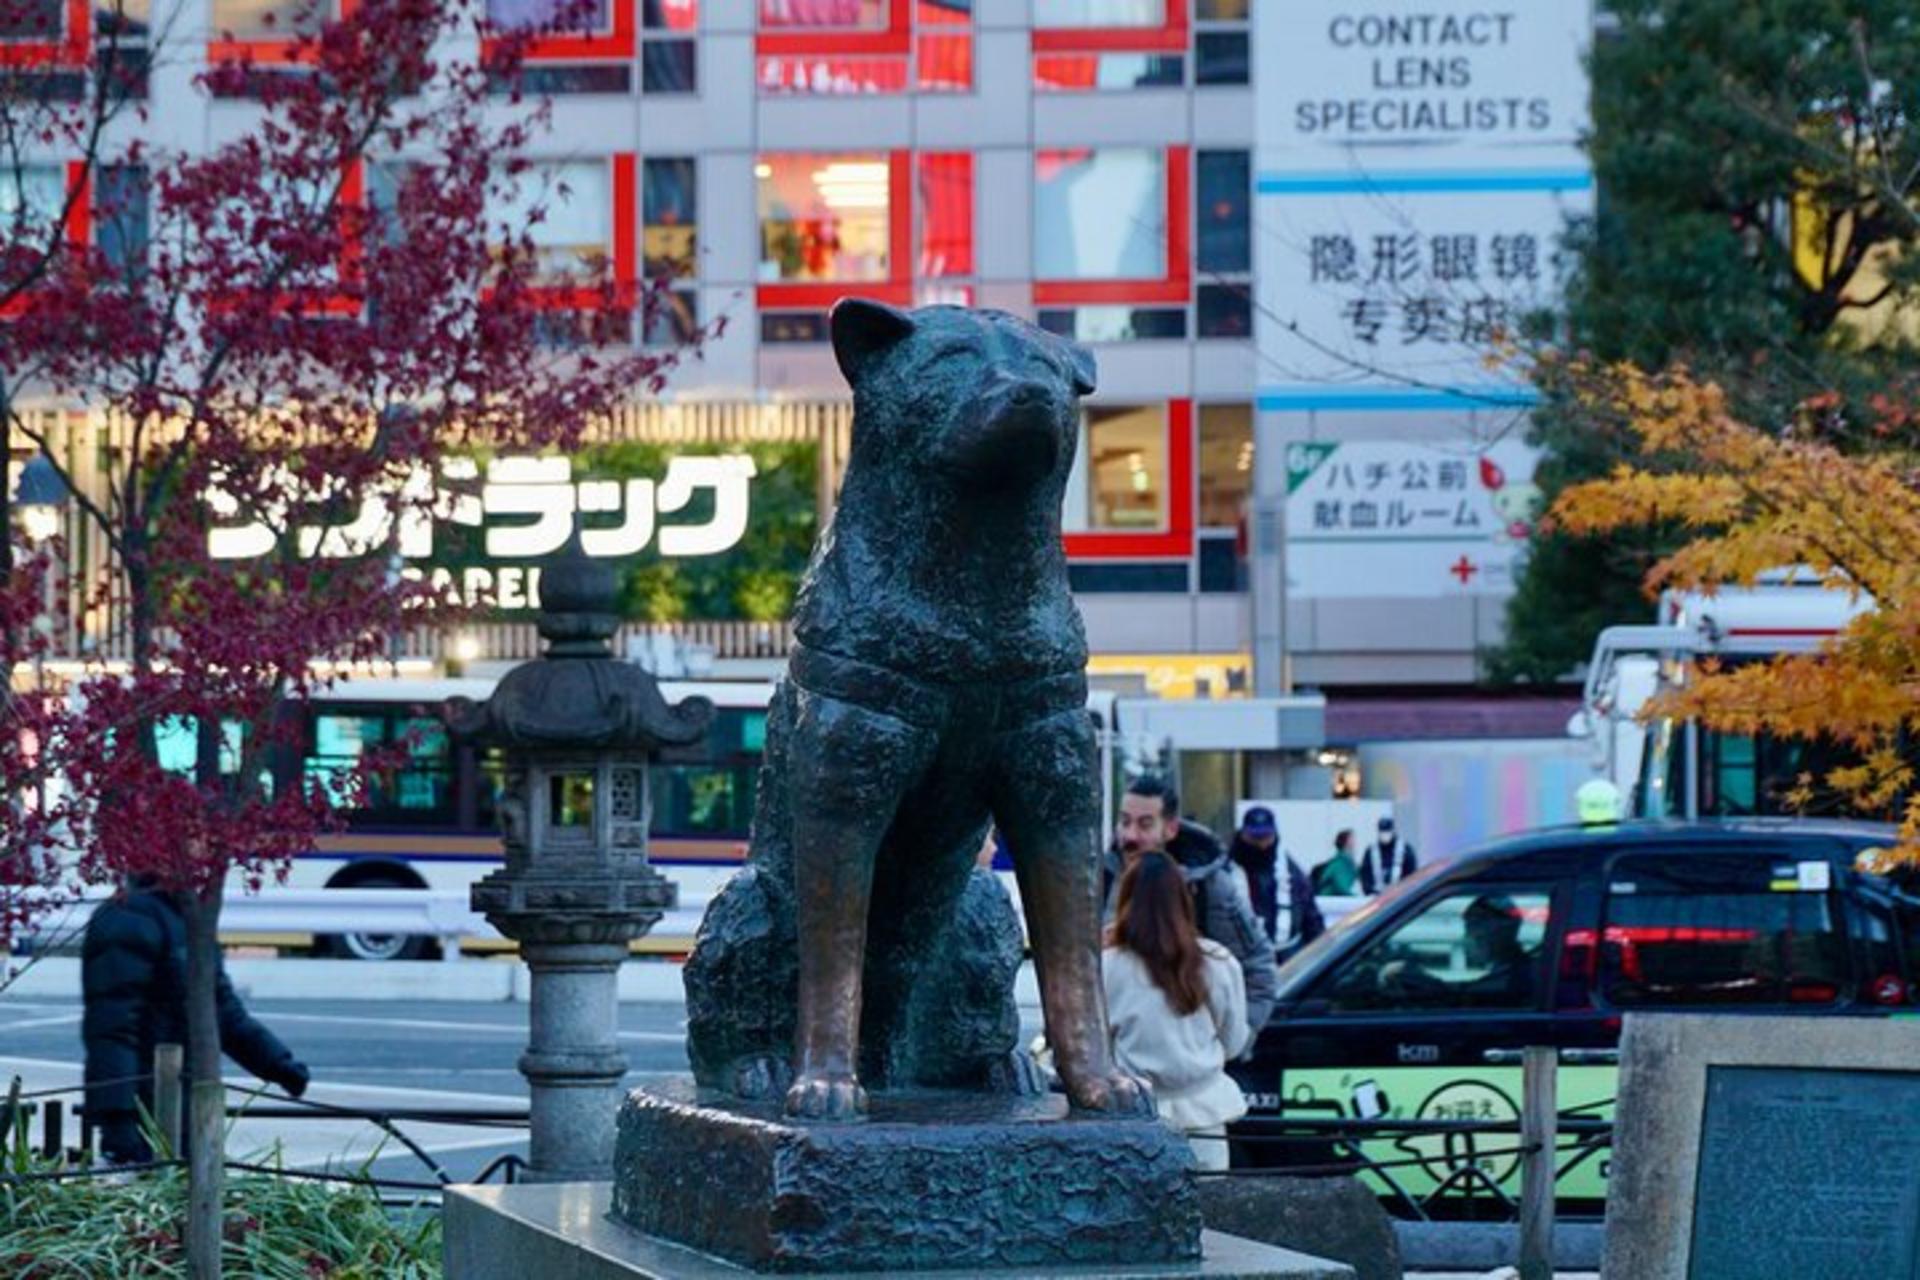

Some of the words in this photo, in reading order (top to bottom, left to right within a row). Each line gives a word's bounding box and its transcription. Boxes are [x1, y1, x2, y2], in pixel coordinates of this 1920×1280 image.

[1328, 13, 1515, 47] CONTACT
[1372, 57, 1472, 90] LENS
[1295, 98, 1551, 133] SPECIALISTS
[1308, 232, 1541, 284] 隐形眼镜
[1326, 460, 1468, 491] ハチ公前
[1313, 499, 1481, 529] 献血ルーム
[1398, 1043, 1438, 1061] km
